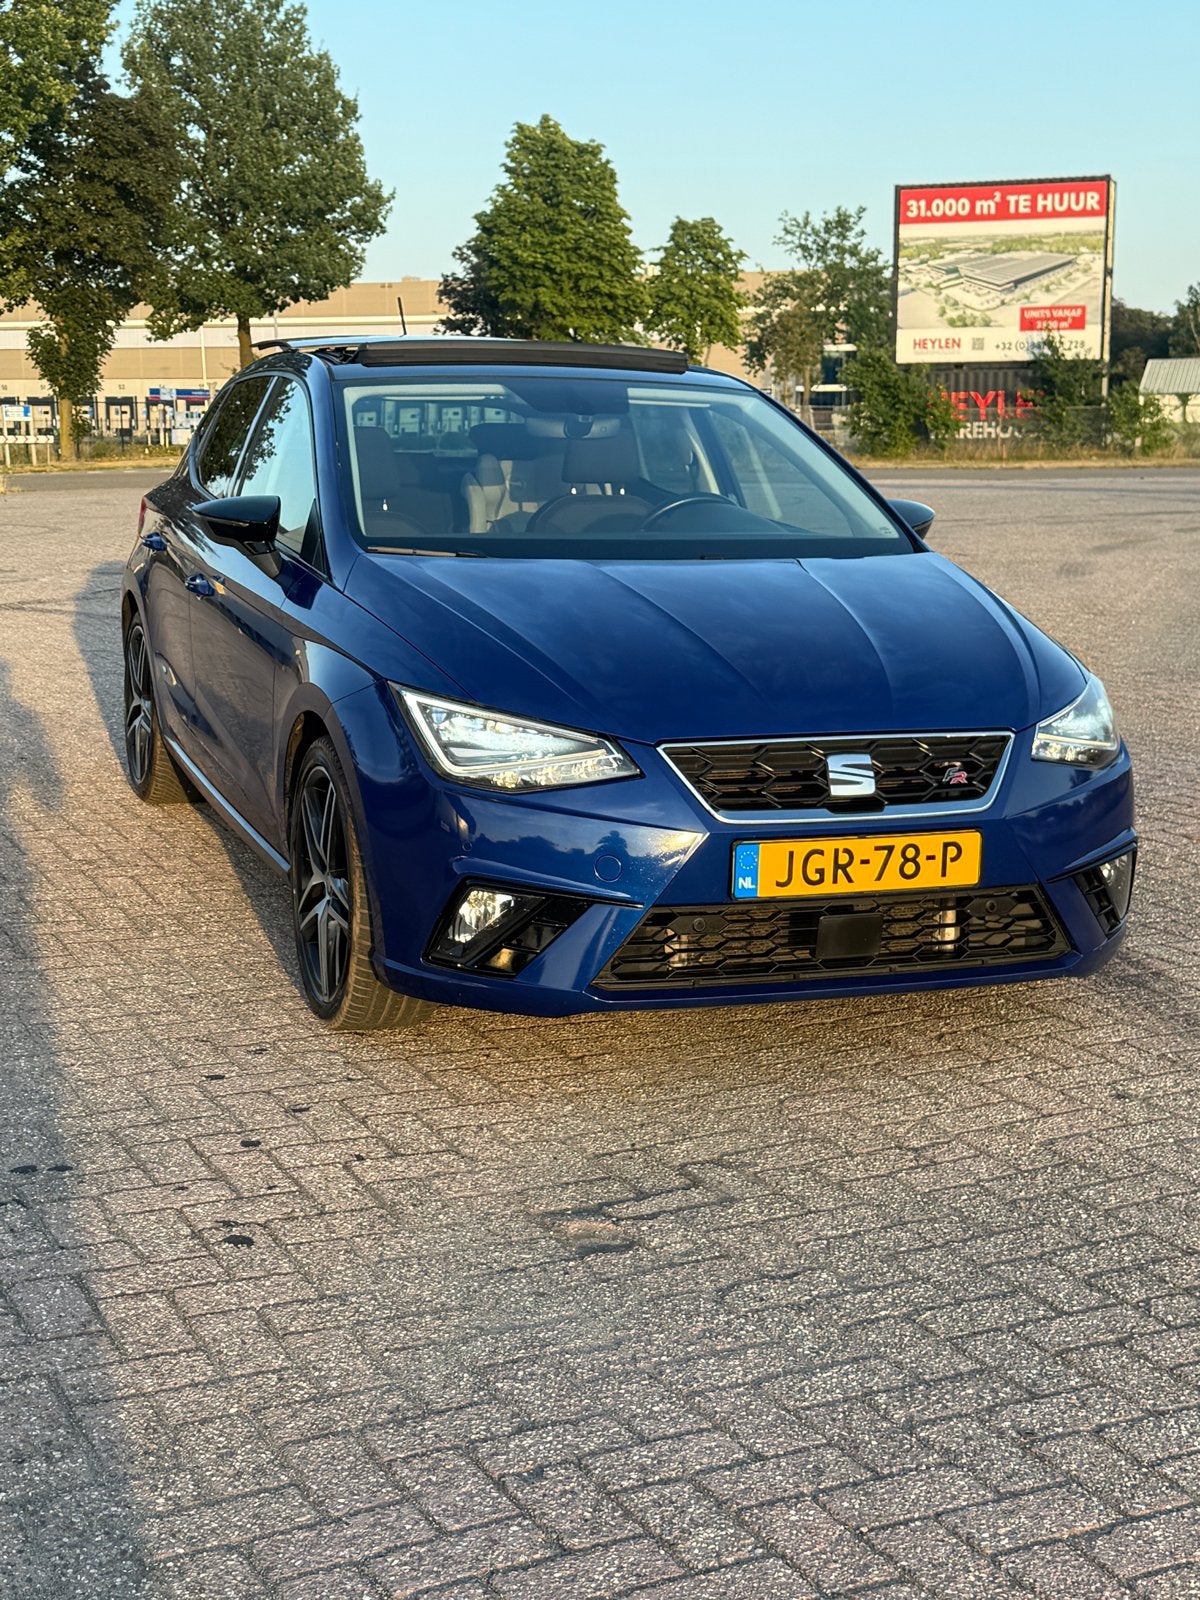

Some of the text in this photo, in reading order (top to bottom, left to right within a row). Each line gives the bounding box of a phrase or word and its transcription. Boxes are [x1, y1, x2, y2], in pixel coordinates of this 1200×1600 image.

[906, 198, 971, 218] 31.000
[1006, 194, 1032, 214] TE
[1037, 191, 1101, 213] HUUR
[1024, 308, 1082, 319] UNITS VANAF
[913, 338, 961, 350] HEYLEN
[775, 841, 963, 888] JGR-78-P
[738, 876, 756, 890] NL
